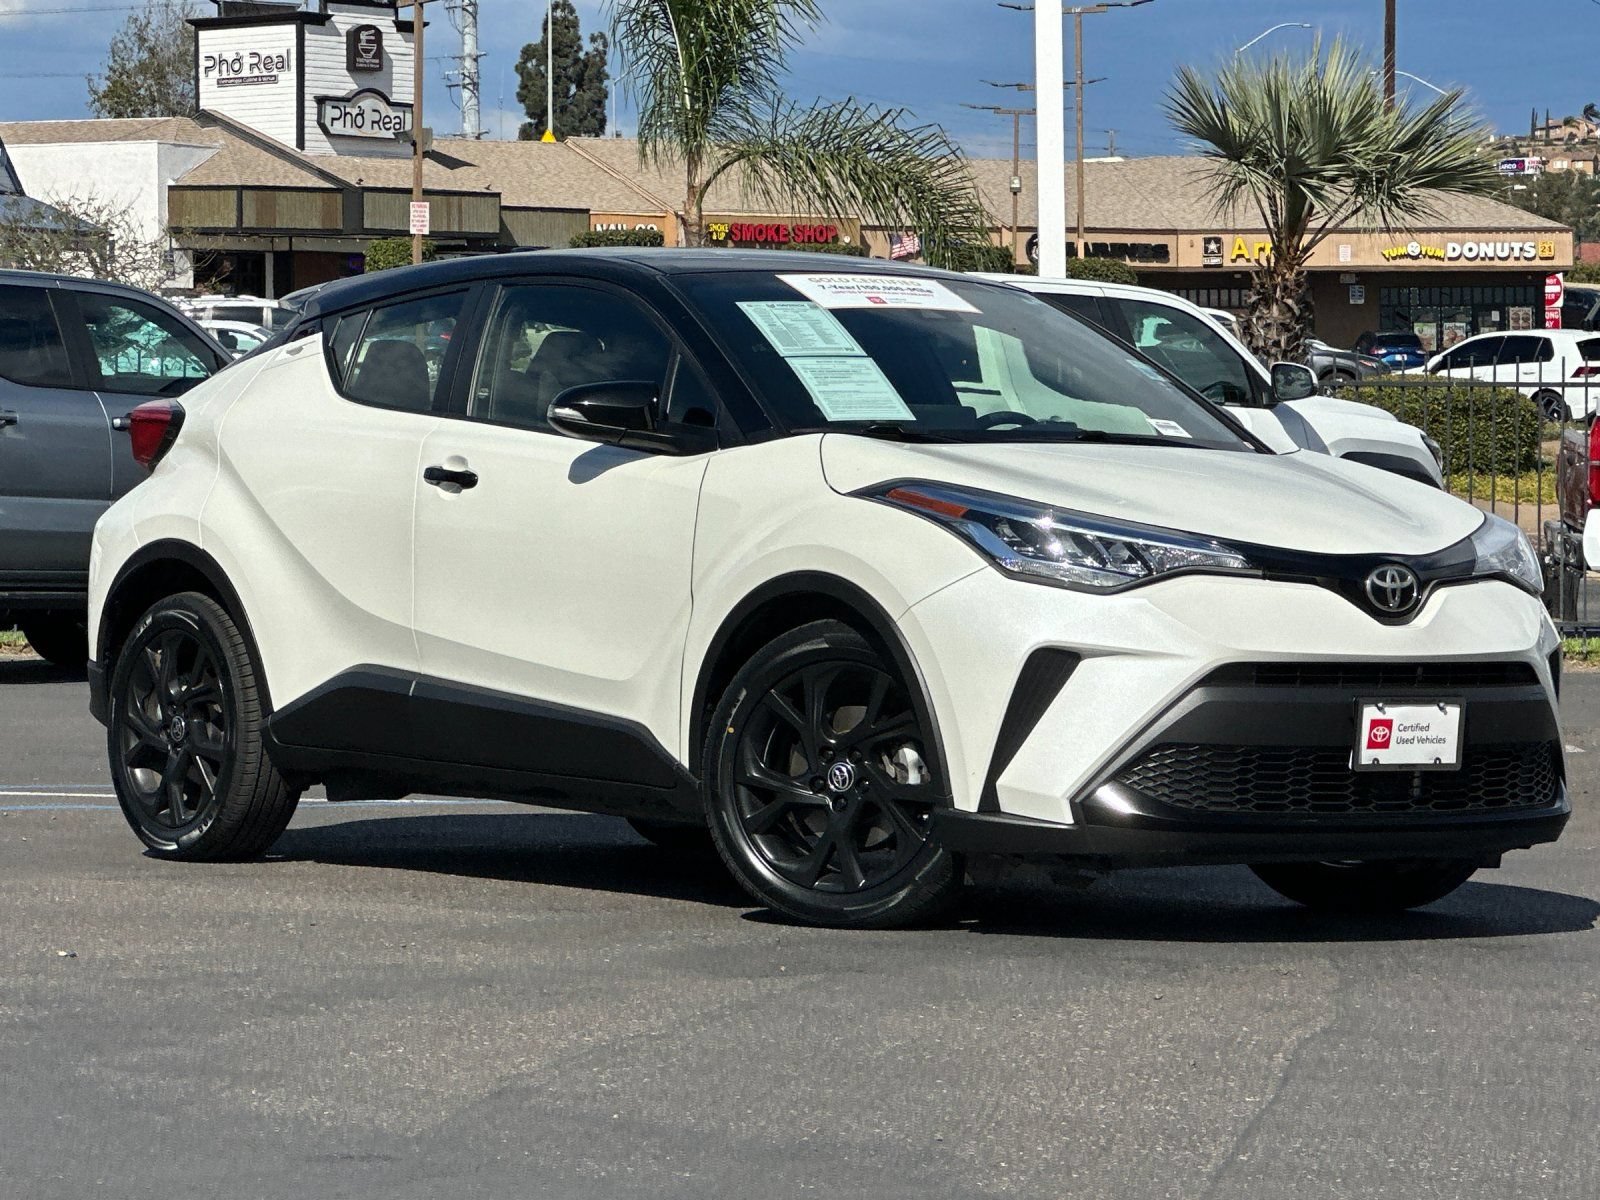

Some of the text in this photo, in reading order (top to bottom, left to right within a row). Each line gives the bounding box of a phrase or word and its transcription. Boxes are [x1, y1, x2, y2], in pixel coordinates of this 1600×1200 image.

[249, 48, 291, 74] Real
[371, 109, 406, 131] Real
[731, 223, 837, 243] SMOKE SHOP
[1382, 242, 1536, 258] YUM YUM DONUTS
[1397, 723, 1430, 732] Certified
[1396, 735, 1446, 744] Used Vehicles
